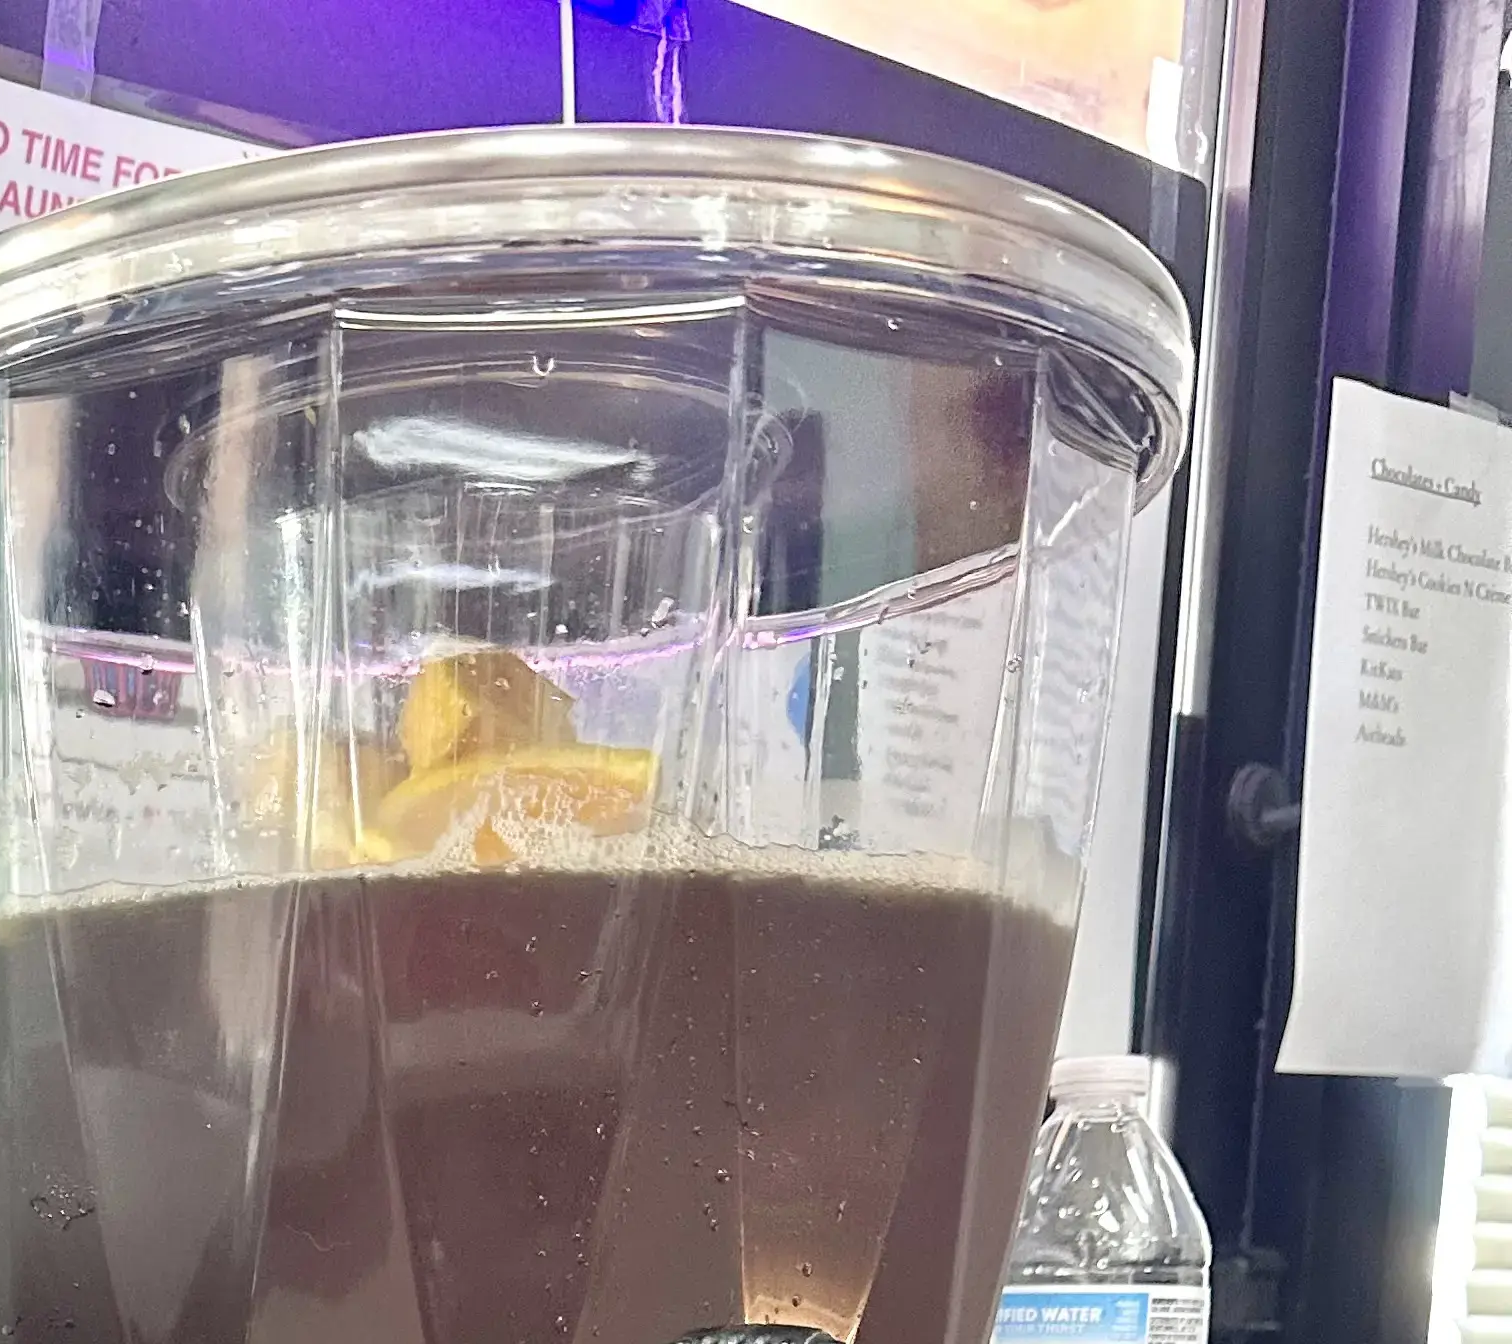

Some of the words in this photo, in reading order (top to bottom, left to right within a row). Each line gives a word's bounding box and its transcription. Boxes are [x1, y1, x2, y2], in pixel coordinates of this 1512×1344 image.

[21, 128, 105, 183] TIME
[1445, 477, 1482, 507] Candy
[1368, 523, 1418, 559] Hershey's
[1419, 536, 1445, 559] Milk
[1447, 544, 1501, 570] Chocolate
[1366, 557, 1417, 591] Hershey's
[1418, 571, 1461, 595] Cookies
[1365, 592, 1399, 617] TWIX
[1402, 600, 1421, 620] Bar
[1409, 634, 1428, 654] Bar
[1042, 1307, 1103, 1323] WATER
